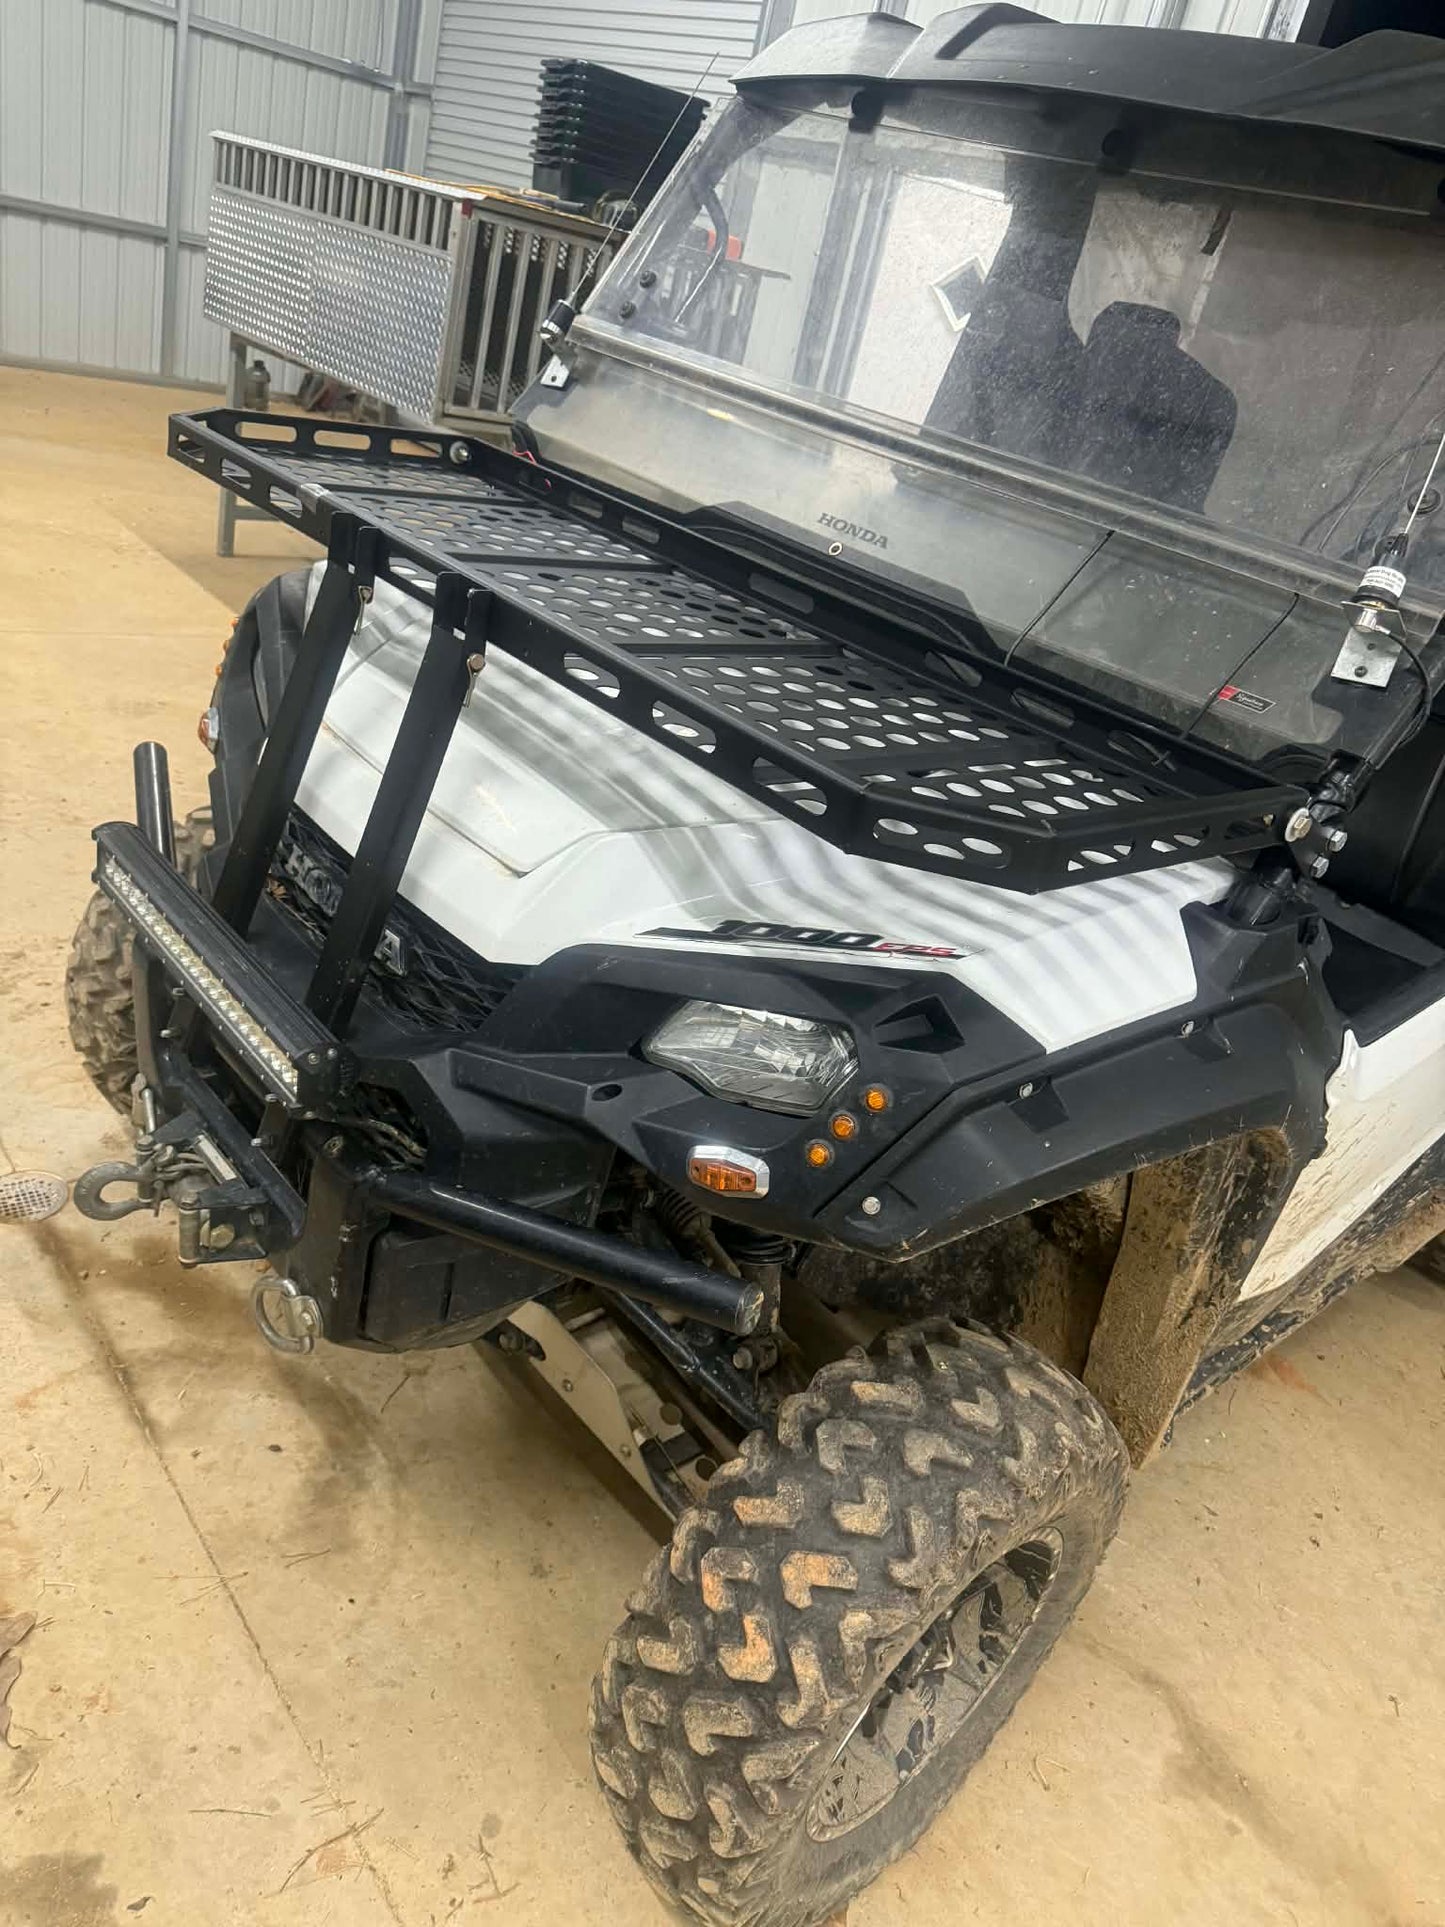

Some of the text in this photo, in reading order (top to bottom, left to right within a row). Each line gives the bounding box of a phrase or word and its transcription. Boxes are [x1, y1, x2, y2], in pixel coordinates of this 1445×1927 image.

[816, 512, 889, 550] HONDA
[711, 919, 957, 957] 1000 EPS
